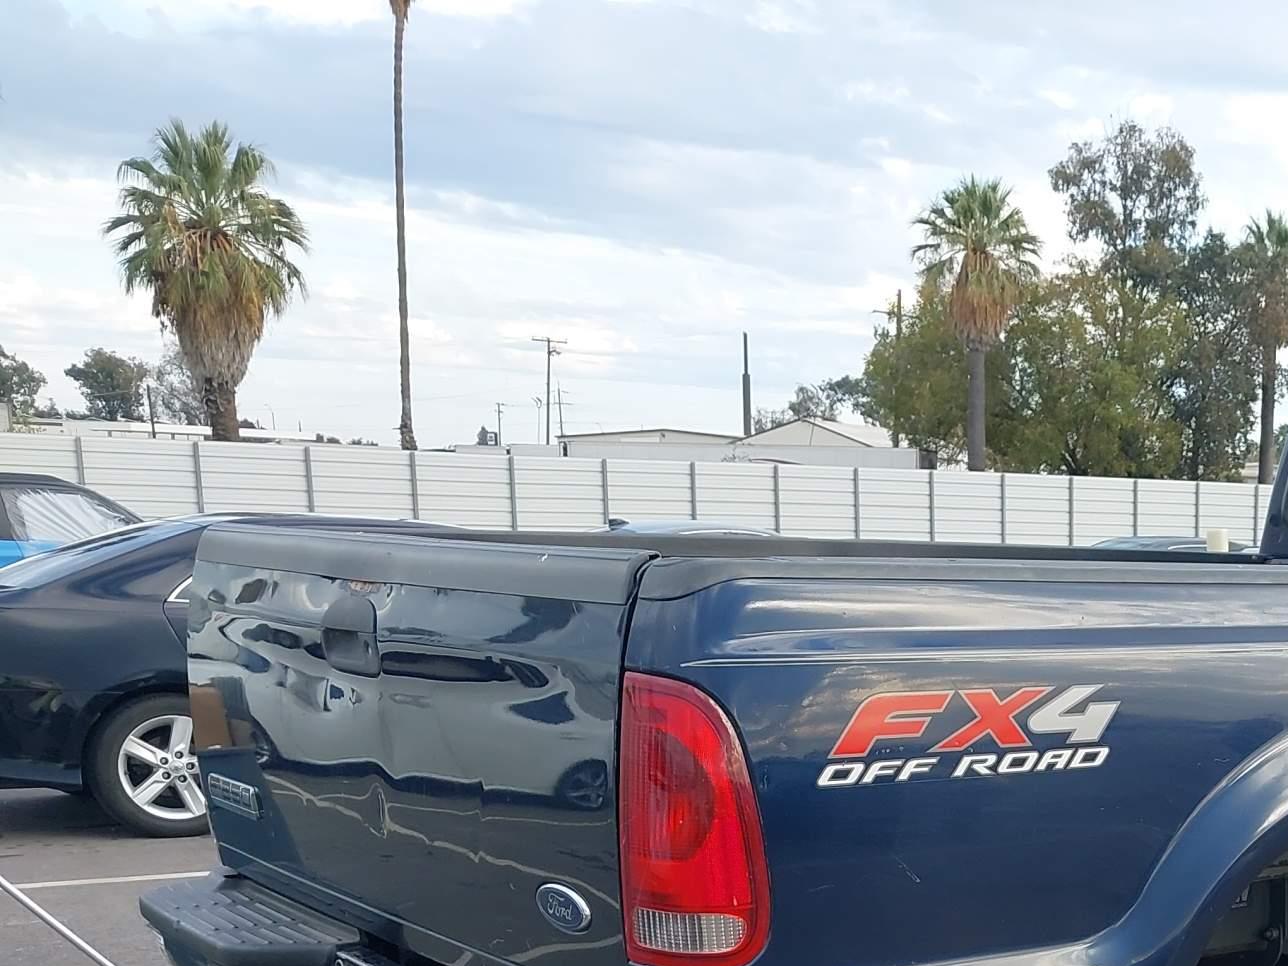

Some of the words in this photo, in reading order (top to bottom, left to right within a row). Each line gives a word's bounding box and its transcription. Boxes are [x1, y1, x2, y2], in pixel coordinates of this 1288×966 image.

[827, 684, 1121, 759] FX4
[816, 756, 940, 788] OFF
[951, 746, 1110, 778] ROAD
[547, 892, 572, 921] Ford
